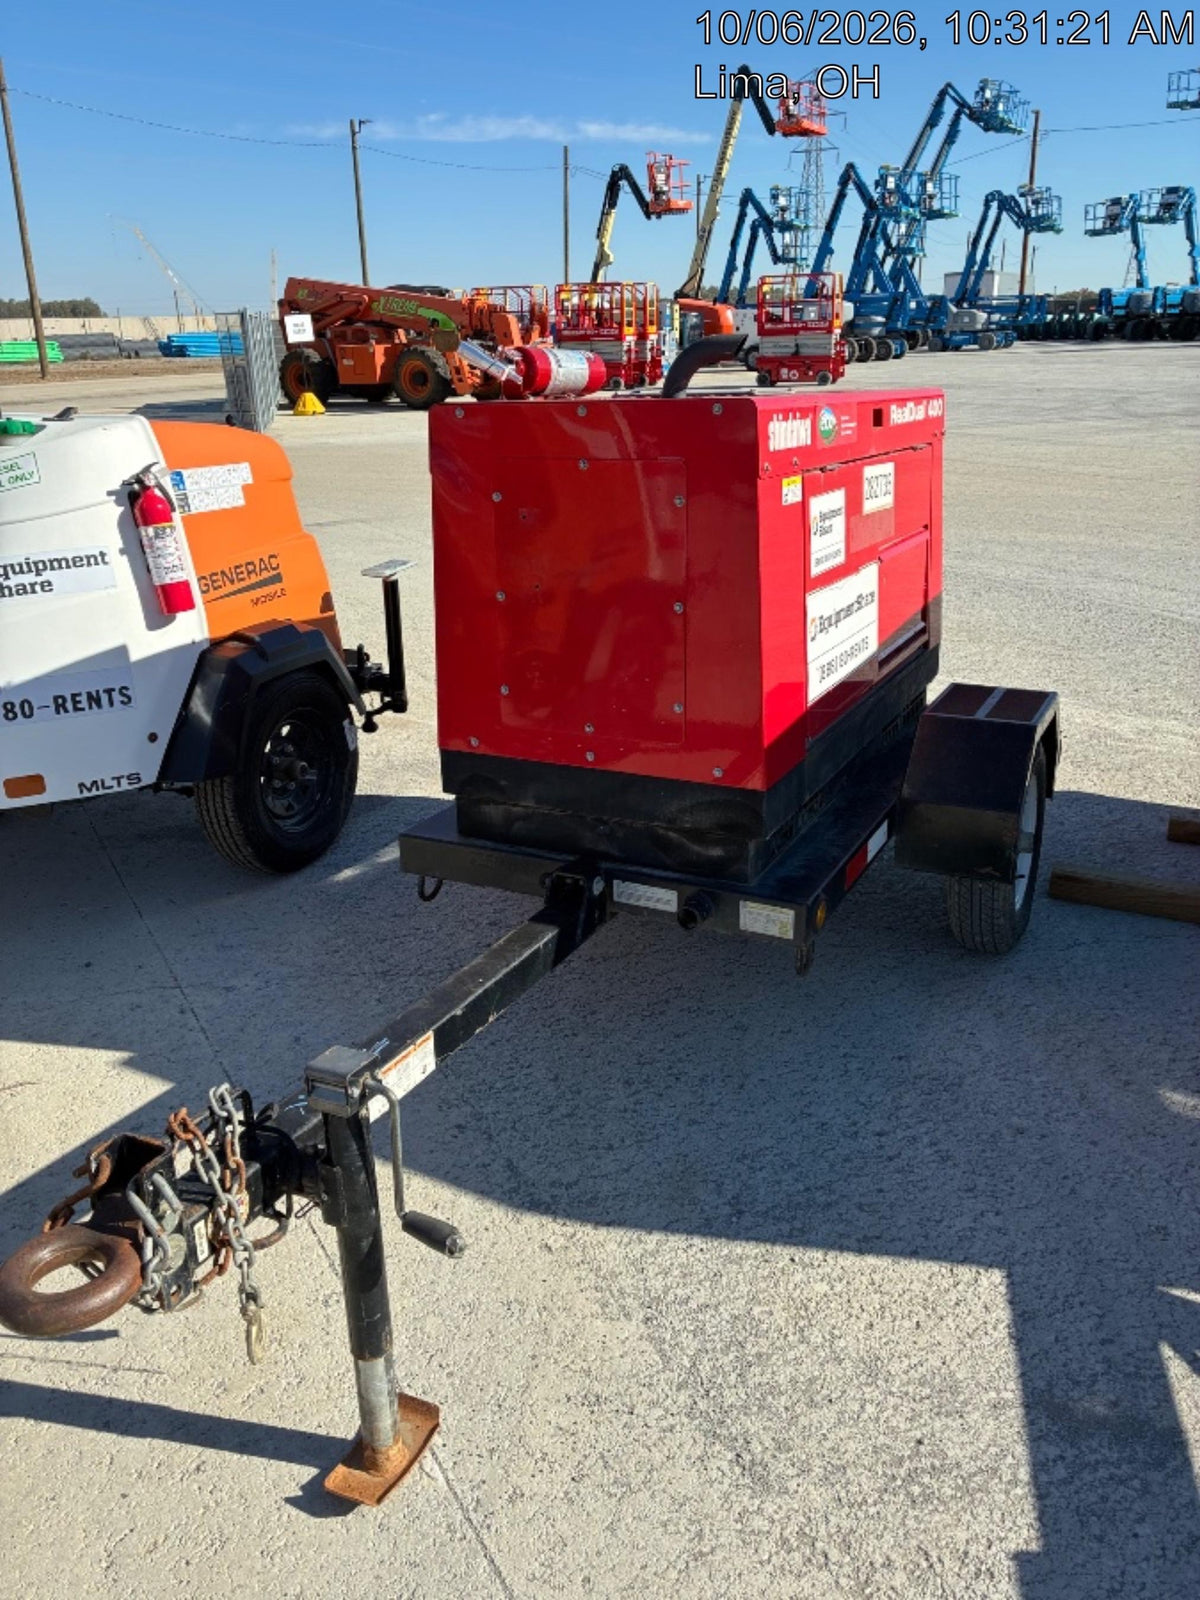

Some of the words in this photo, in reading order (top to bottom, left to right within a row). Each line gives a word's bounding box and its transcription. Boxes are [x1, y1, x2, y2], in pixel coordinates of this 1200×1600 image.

[768, 413, 812, 452] shindaiwa
[8, 470, 34, 485] ONLY
[198, 554, 280, 594] GENERAC
[2, 686, 132, 722] 80-RENTS
[78, 772, 143, 794] MLTS
